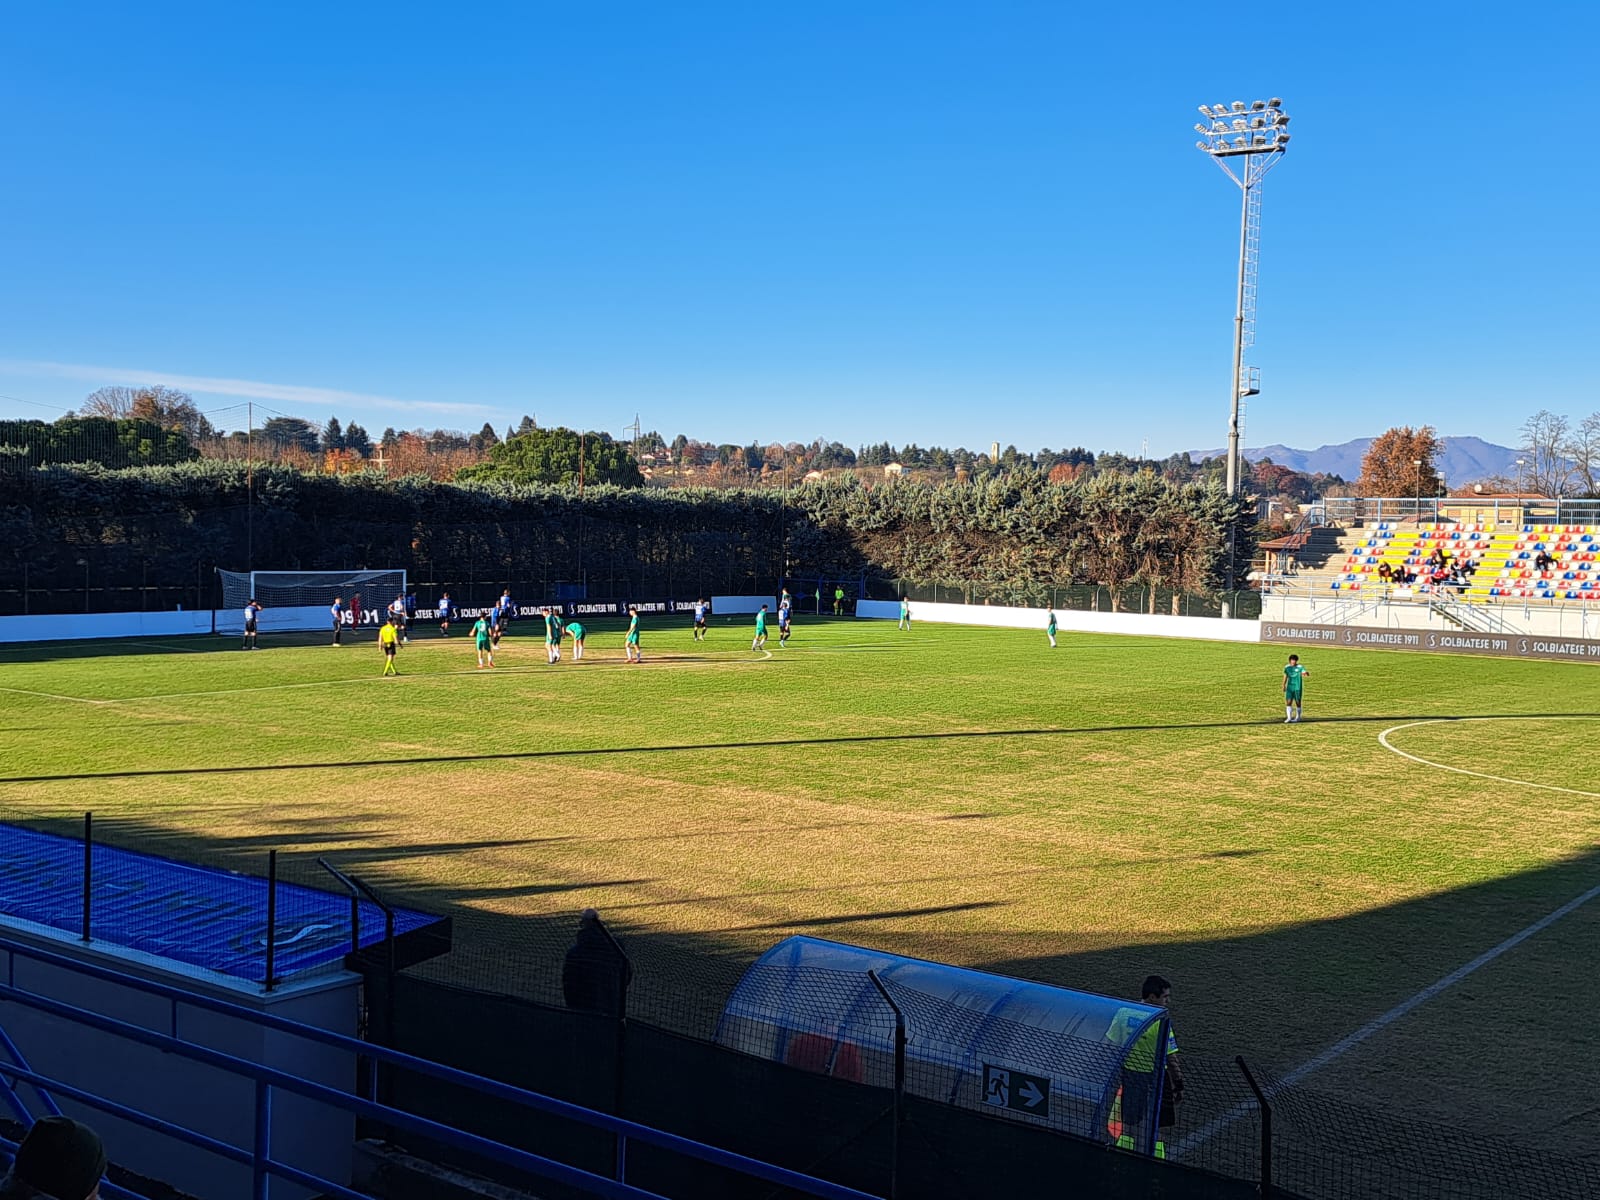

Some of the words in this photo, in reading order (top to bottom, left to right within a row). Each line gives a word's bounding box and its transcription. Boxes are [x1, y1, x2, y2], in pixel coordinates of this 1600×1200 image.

[577, 604, 606, 613] SOLBIATESE
[1276, 628, 1320, 639] SOLBIATESE
[1322, 630, 1336, 640] 1911
[1355, 632, 1402, 644] SOLBIATESE
[1404, 634, 1419, 645] 1911
[1439, 636, 1489, 649] SOLBIATESE
[1491, 639, 1507, 650] 1911
[1532, 641, 1585, 655] SOLBIATESE
[1587, 645, 1600, 656] 191
